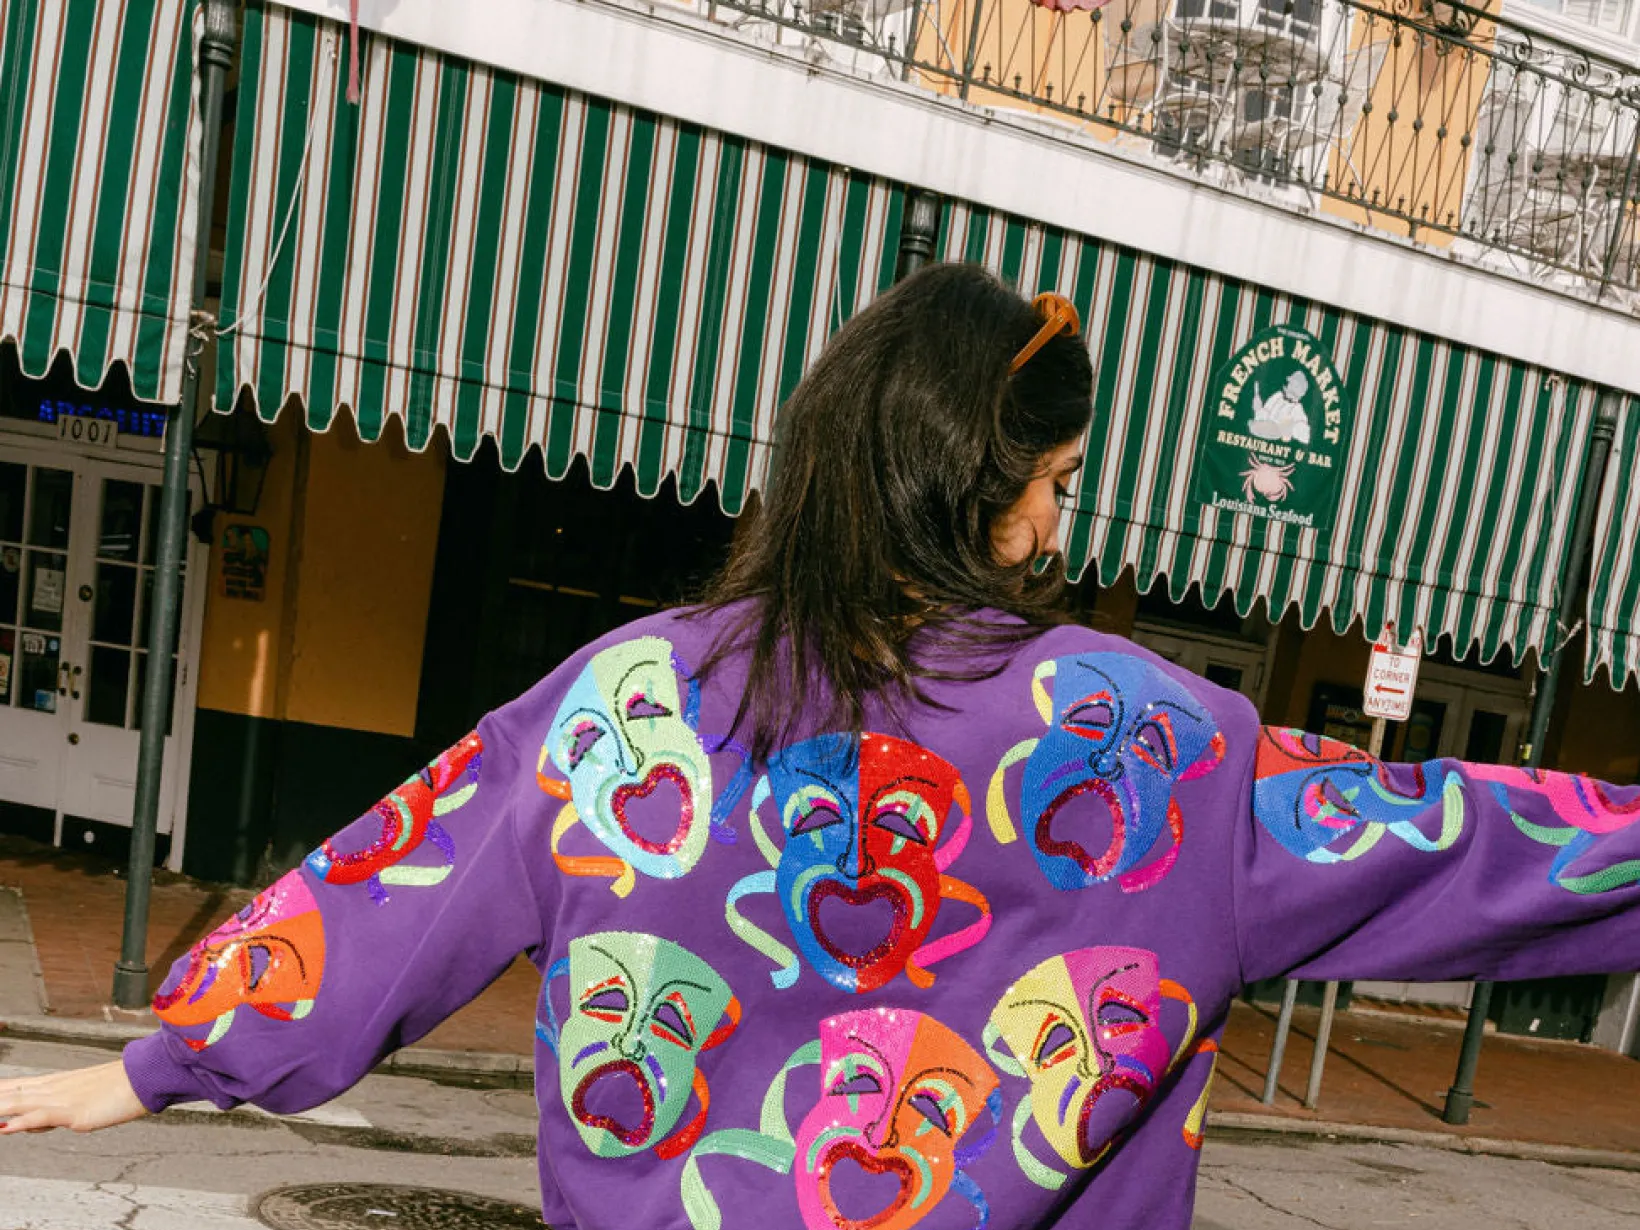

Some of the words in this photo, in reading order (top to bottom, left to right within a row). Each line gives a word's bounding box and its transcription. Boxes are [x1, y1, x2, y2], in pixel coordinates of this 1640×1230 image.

[1218, 336, 1284, 420] FRENCH
[1292, 340, 1341, 444] MARKET
[60, 417, 112, 443] 1001
[1217, 430, 1292, 458] RESTAURANT
[1307, 451, 1332, 468] BAR
[1211, 491, 1267, 517] Louisiana
[1268, 504, 1314, 526] Seafood
[1374, 669, 1410, 684] CORNER
